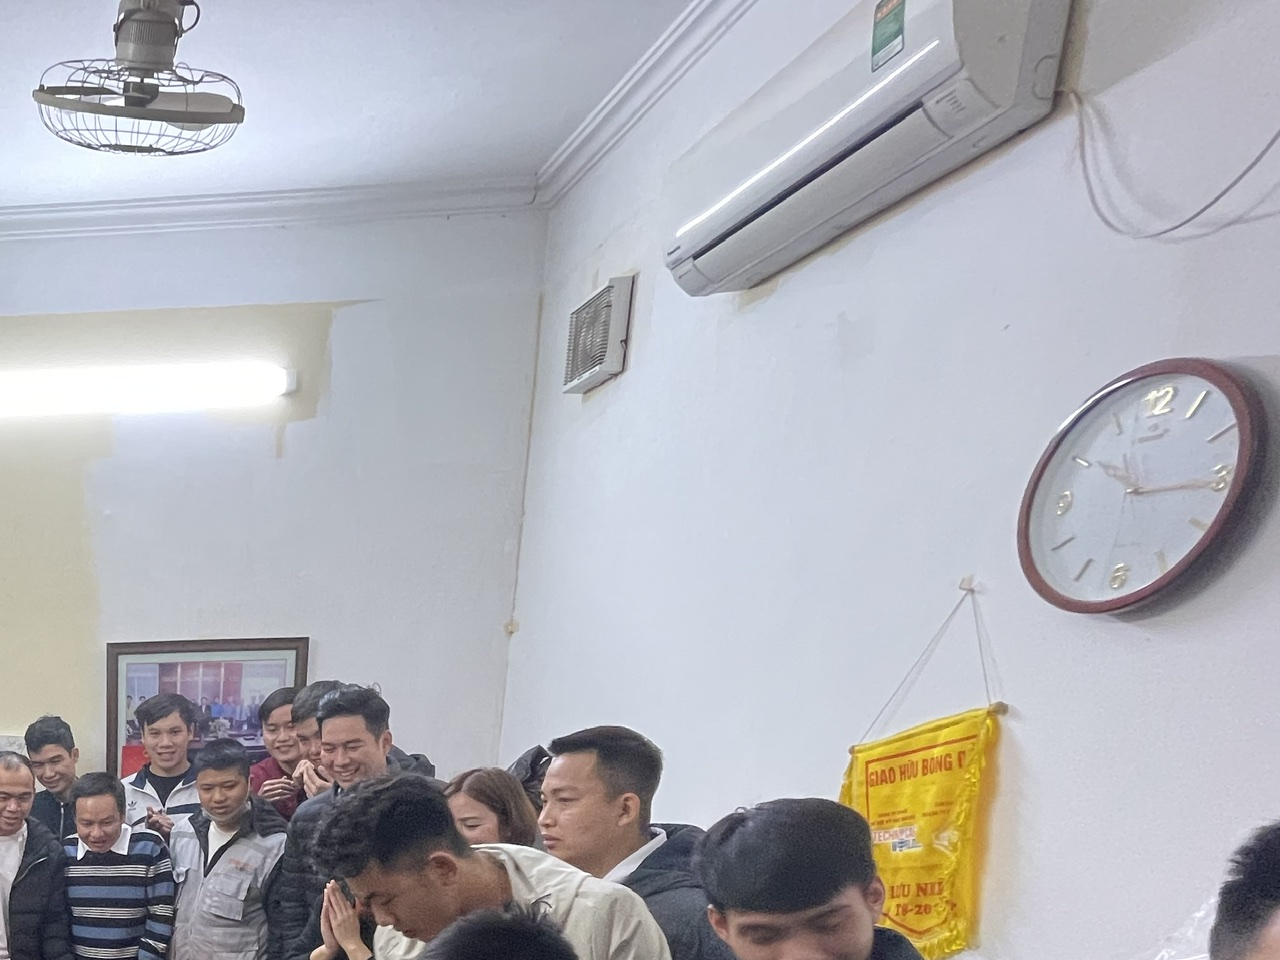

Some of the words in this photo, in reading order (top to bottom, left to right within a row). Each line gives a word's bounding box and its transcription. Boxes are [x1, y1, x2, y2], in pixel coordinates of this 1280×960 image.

[1142, 386, 1176, 418] 12
[1055, 490, 1073, 515] 9
[1108, 562, 1128, 589] 6
[869, 766, 897, 787] GIAO
